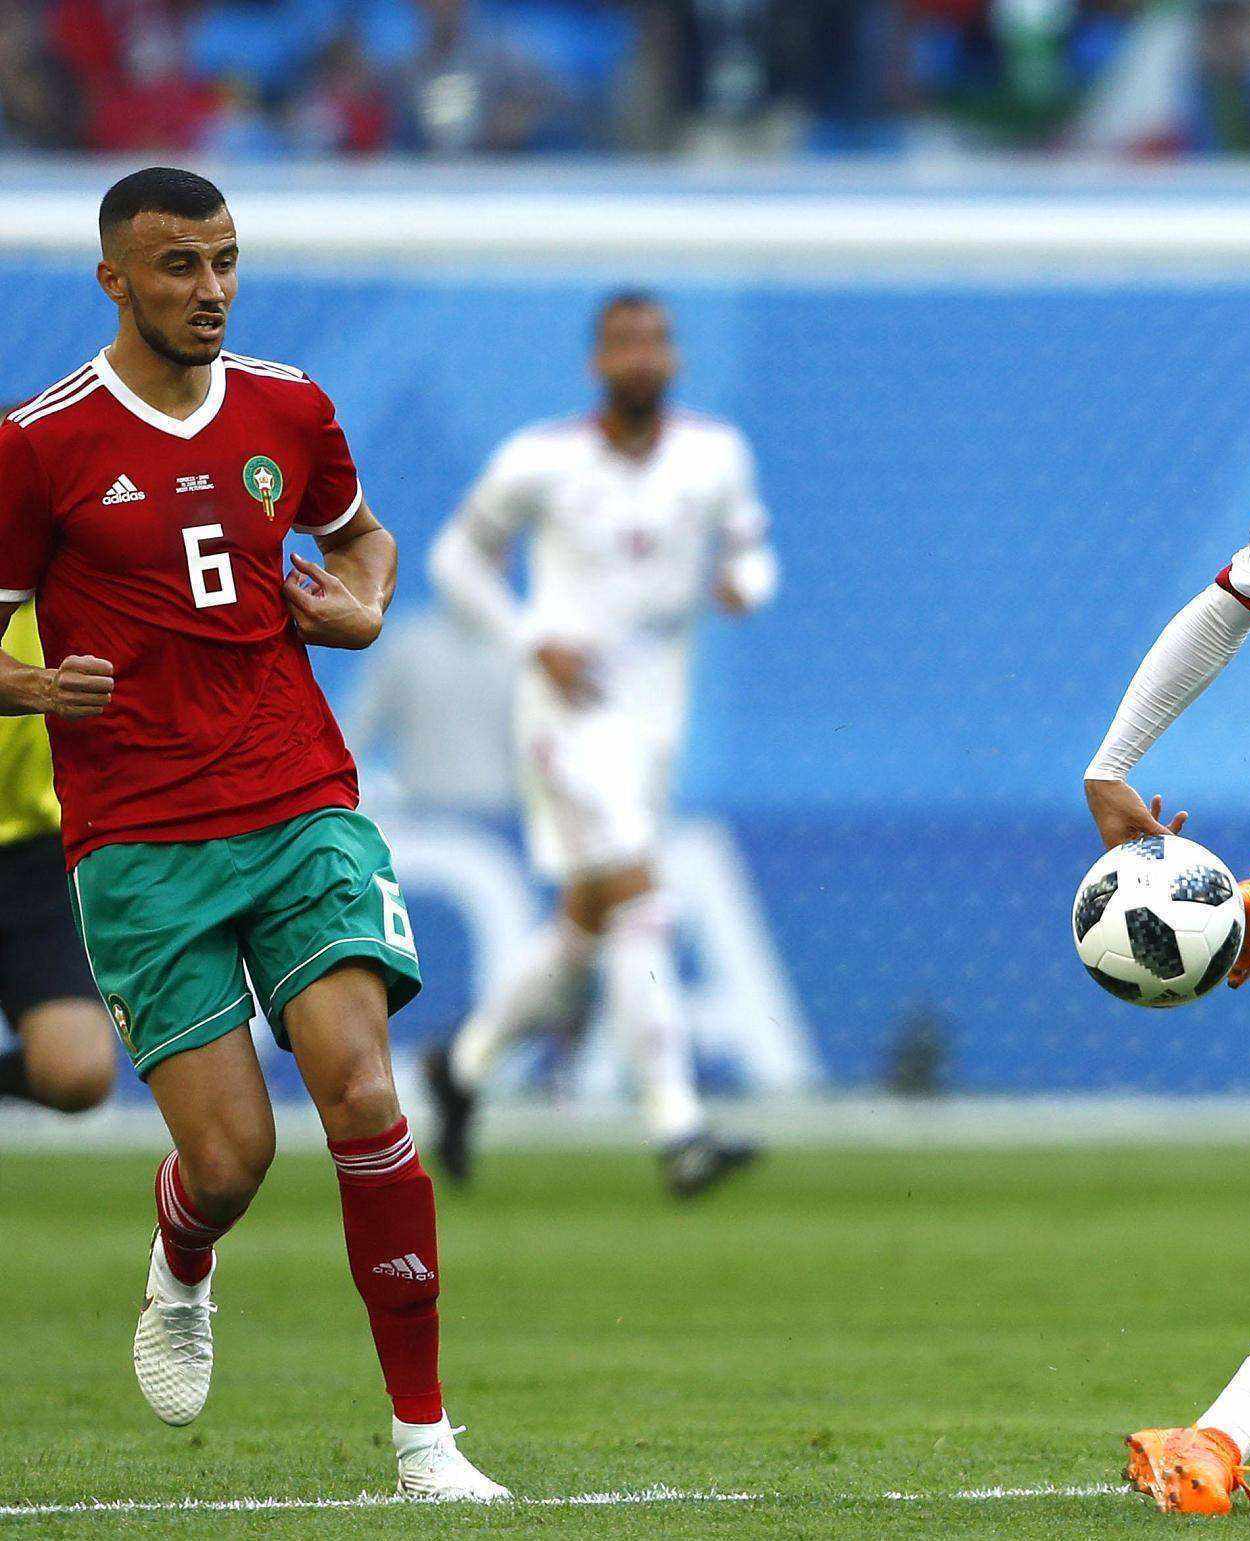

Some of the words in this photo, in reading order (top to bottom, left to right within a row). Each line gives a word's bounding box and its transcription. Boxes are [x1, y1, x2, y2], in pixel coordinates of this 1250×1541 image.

[102, 491, 146, 505] adidas
[181, 523, 238, 609] 6
[373, 873, 416, 954] 6
[372, 1265, 435, 1282] adidas
